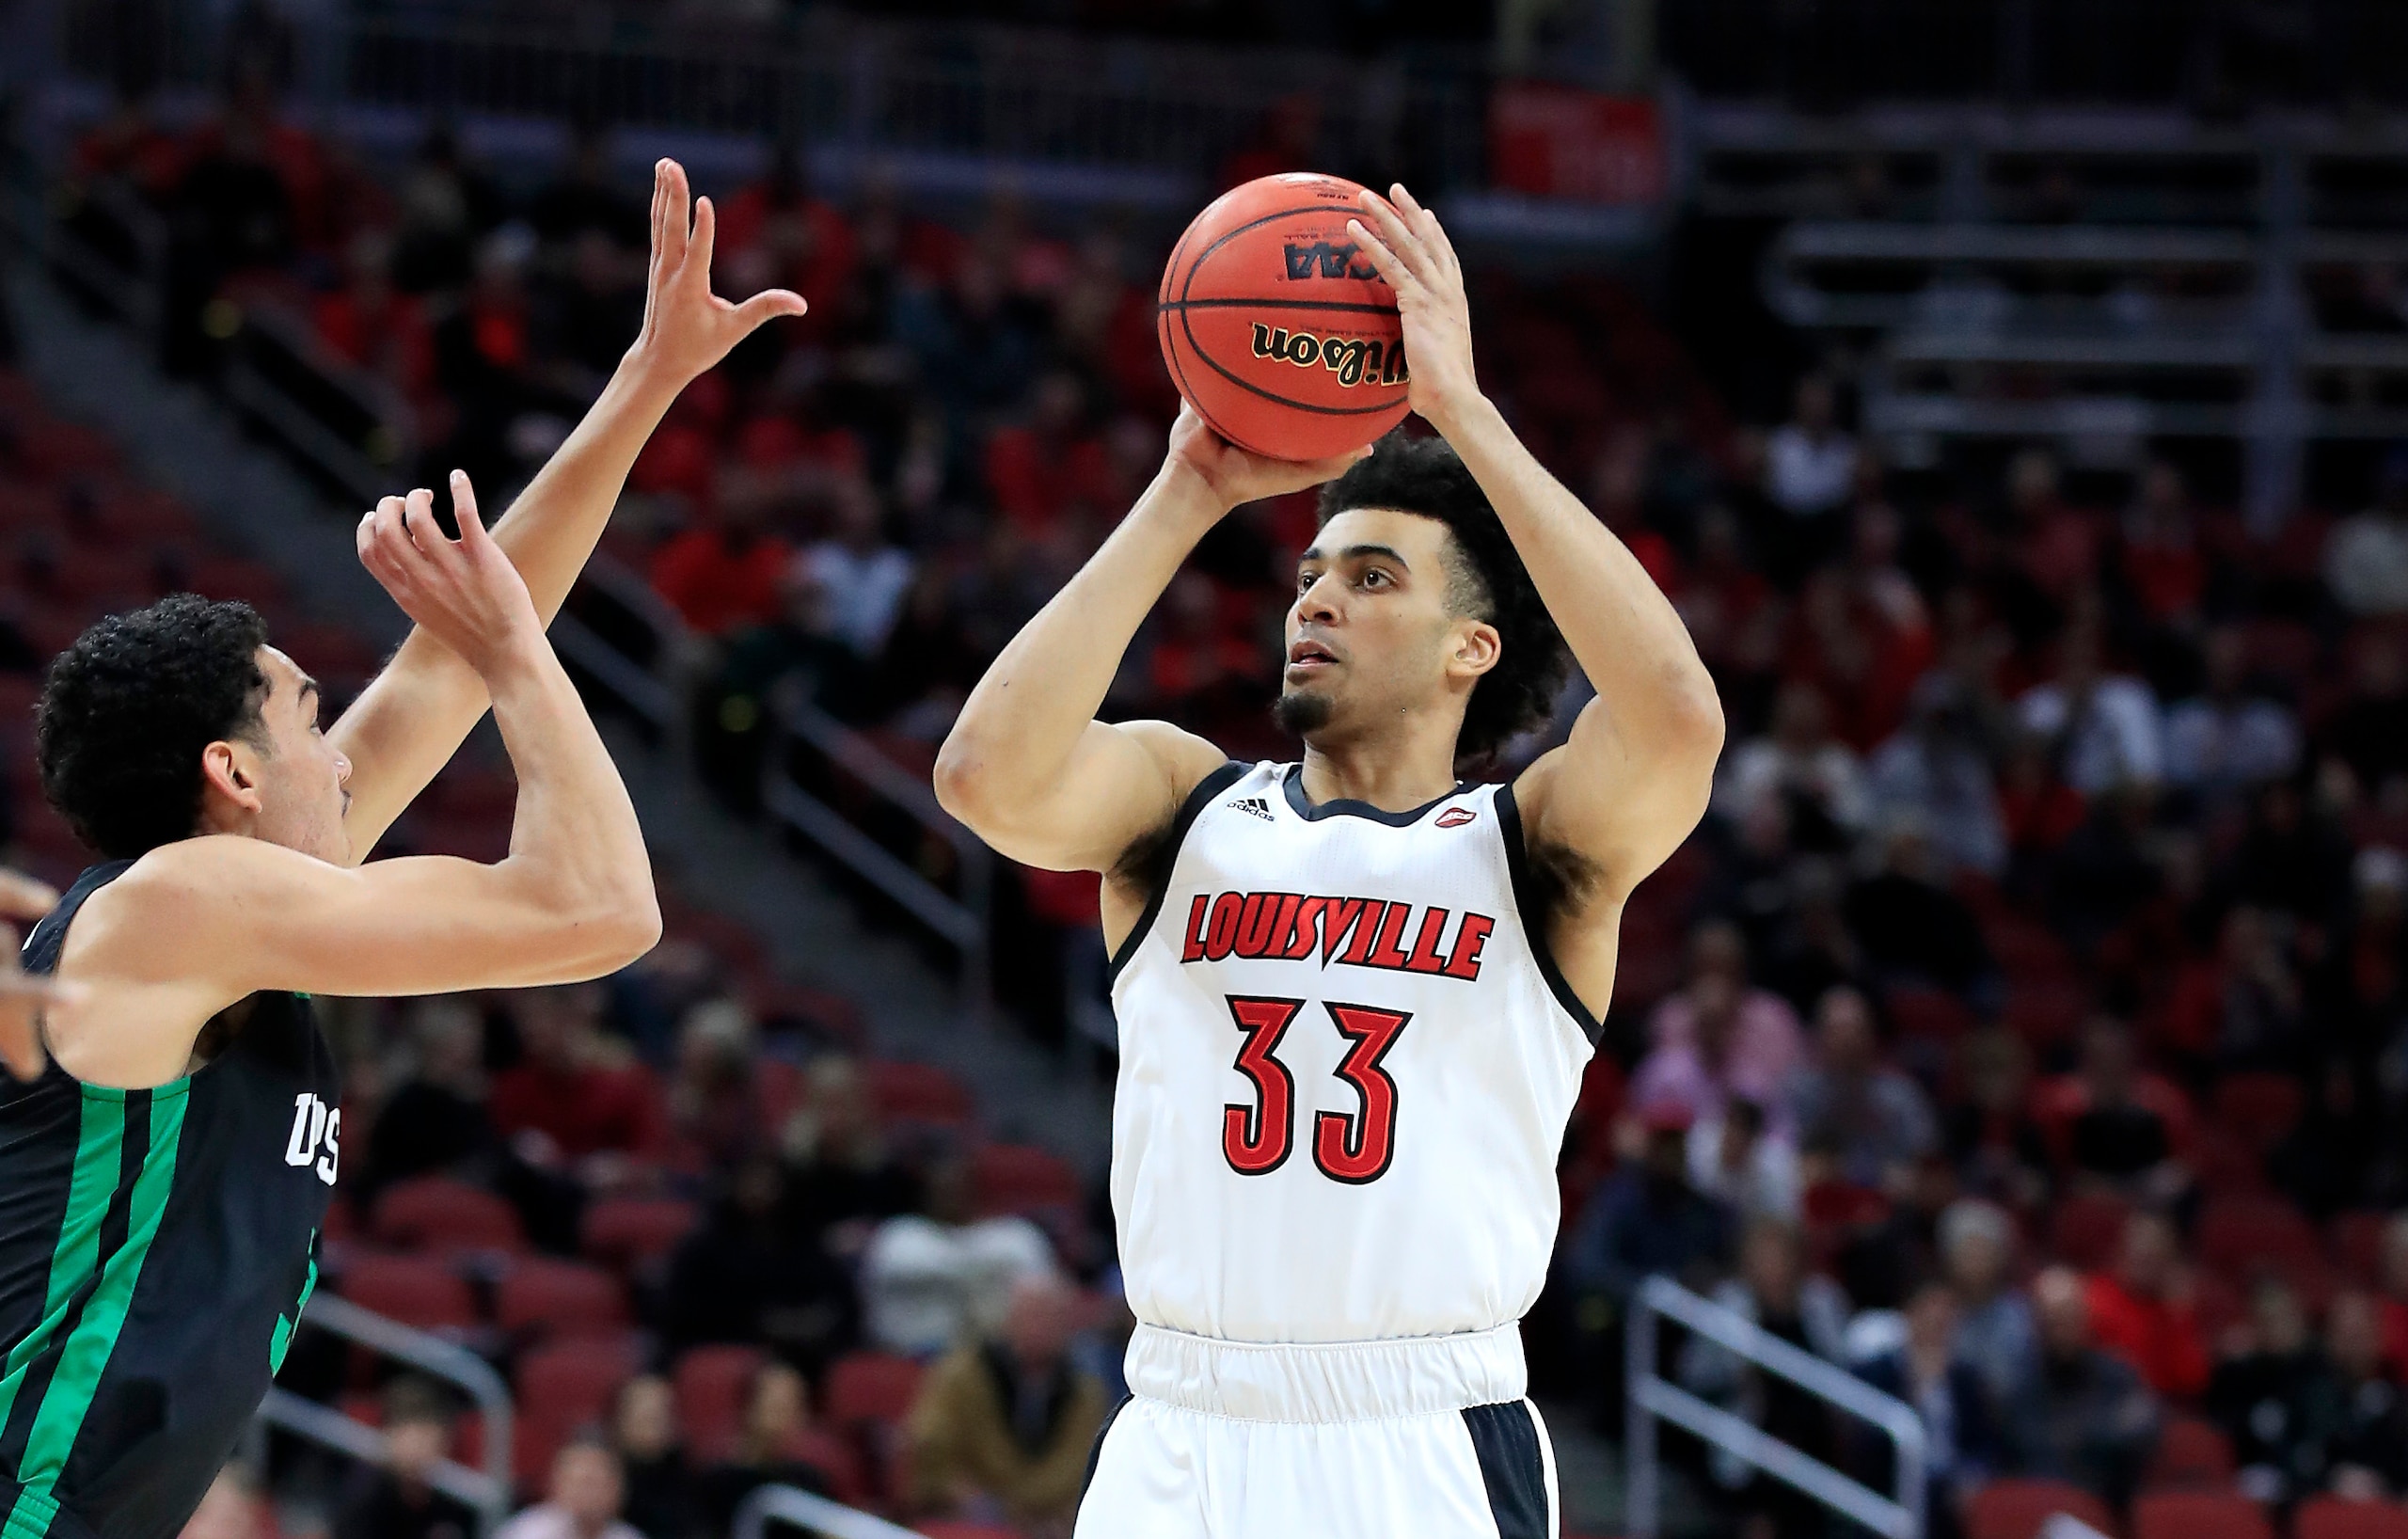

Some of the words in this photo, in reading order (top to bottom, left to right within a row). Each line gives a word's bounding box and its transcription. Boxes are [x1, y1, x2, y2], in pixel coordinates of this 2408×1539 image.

[1284, 243, 1386, 283] CAA
[1227, 801, 1275, 822] adidas
[1180, 891, 1497, 982] LOUISVILLE
[1222, 994, 1414, 1185] 33
